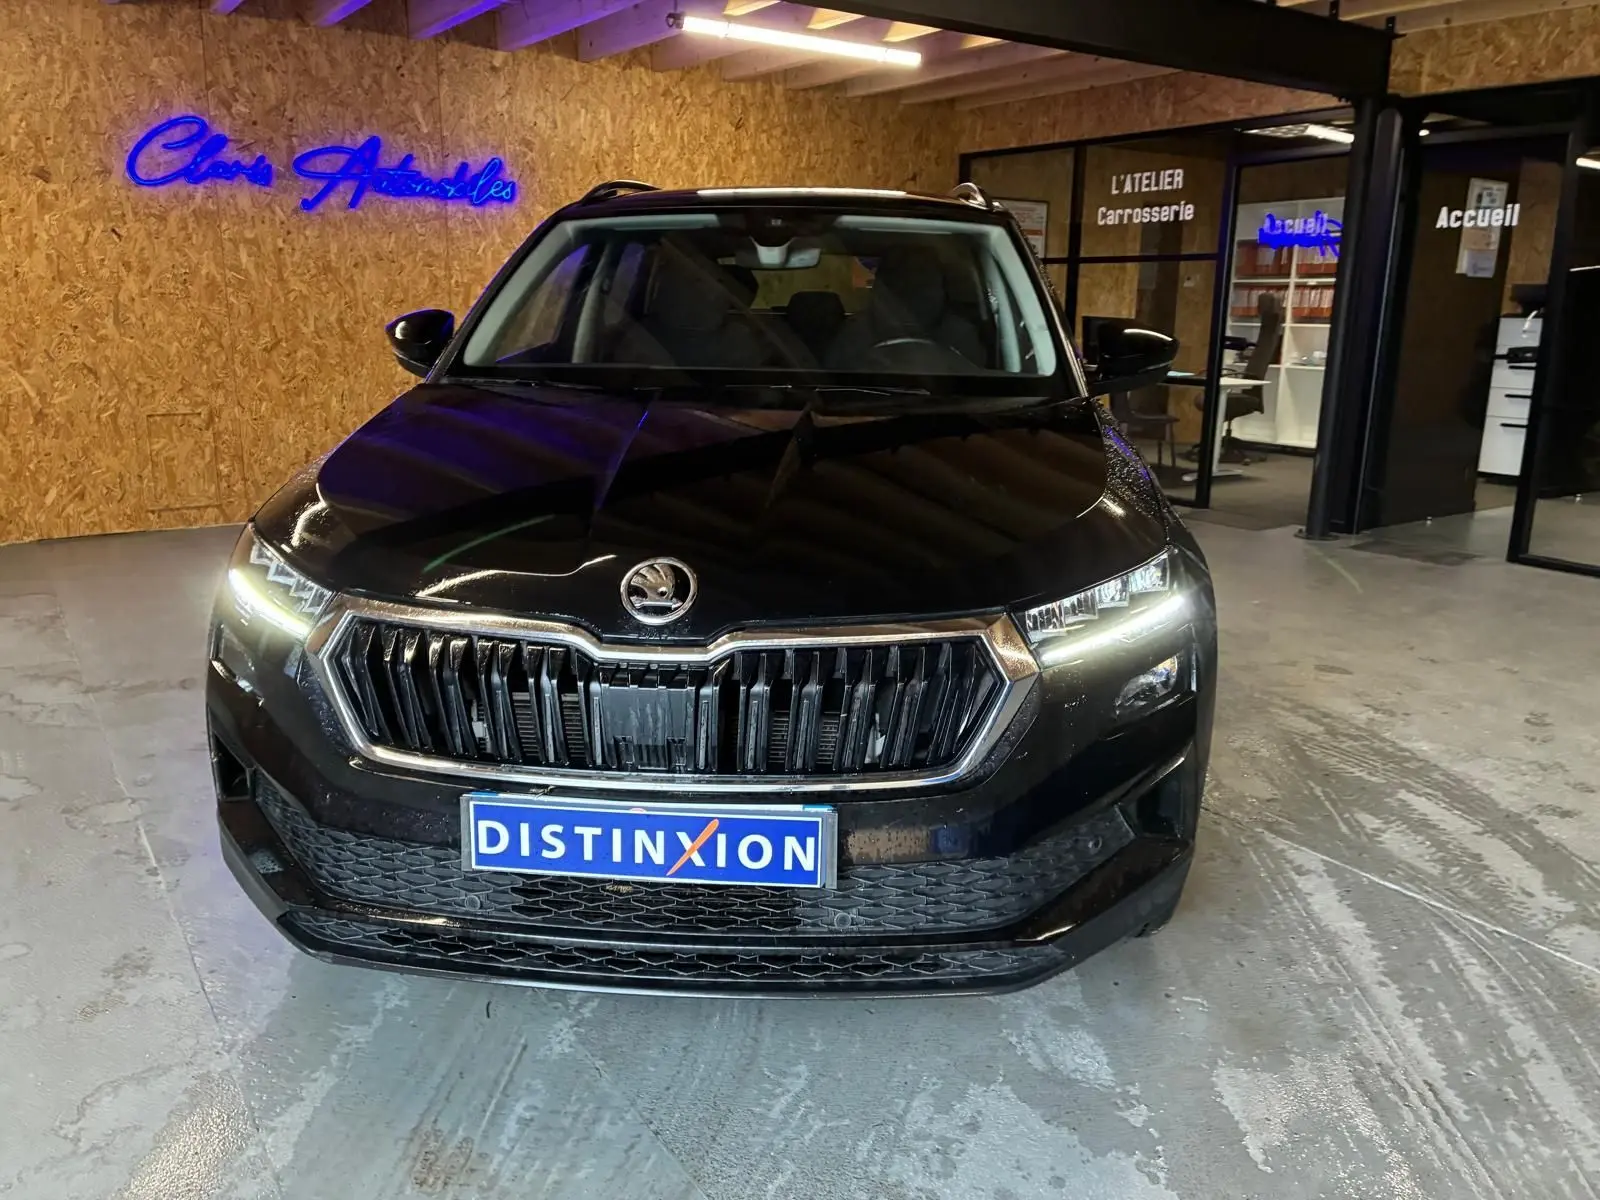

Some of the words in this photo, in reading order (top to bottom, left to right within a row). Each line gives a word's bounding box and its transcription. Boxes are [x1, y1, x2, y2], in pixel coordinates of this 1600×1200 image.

[1111, 168, 1184, 195] L'ATELIER
[1097, 200, 1195, 226] Carrosserie
[1435, 203, 1521, 229] Accueil
[476, 818, 817, 876] DISTINXION
